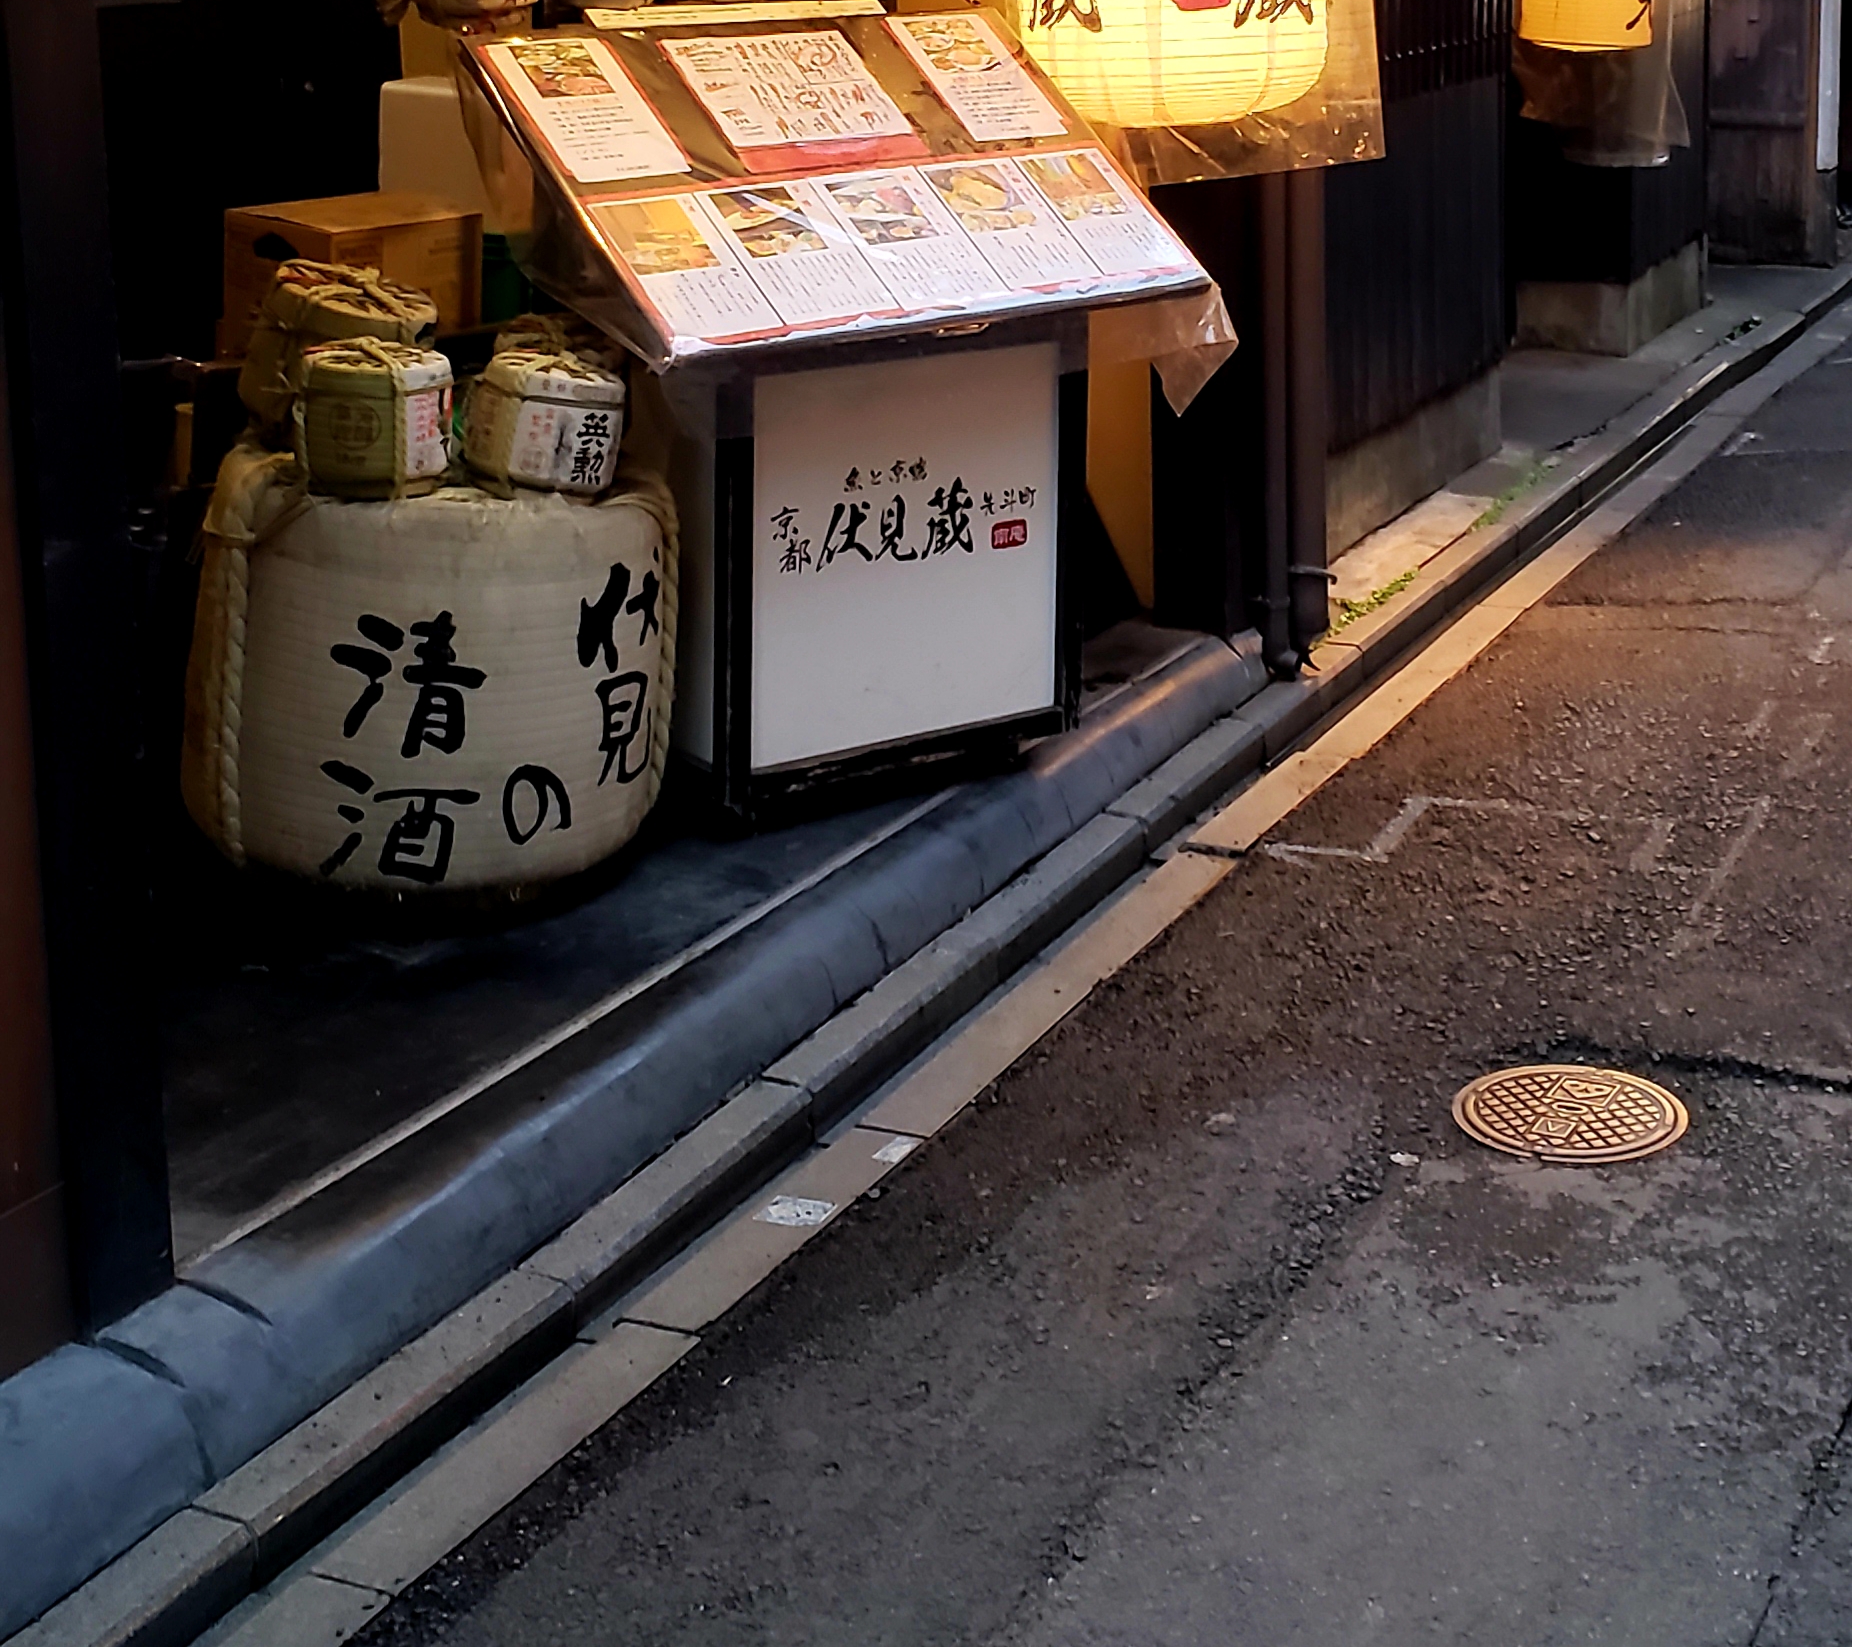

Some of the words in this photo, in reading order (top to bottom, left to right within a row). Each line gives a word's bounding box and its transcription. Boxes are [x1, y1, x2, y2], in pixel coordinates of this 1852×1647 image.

[570, 413, 611, 486] 英勲
[770, 506, 813, 575] 京都
[815, 476, 975, 573] 伏見蔵
[979, 488, 1038, 517] 先斗町
[319, 610, 488, 885] 清酒
[502, 764, 573, 845] の
